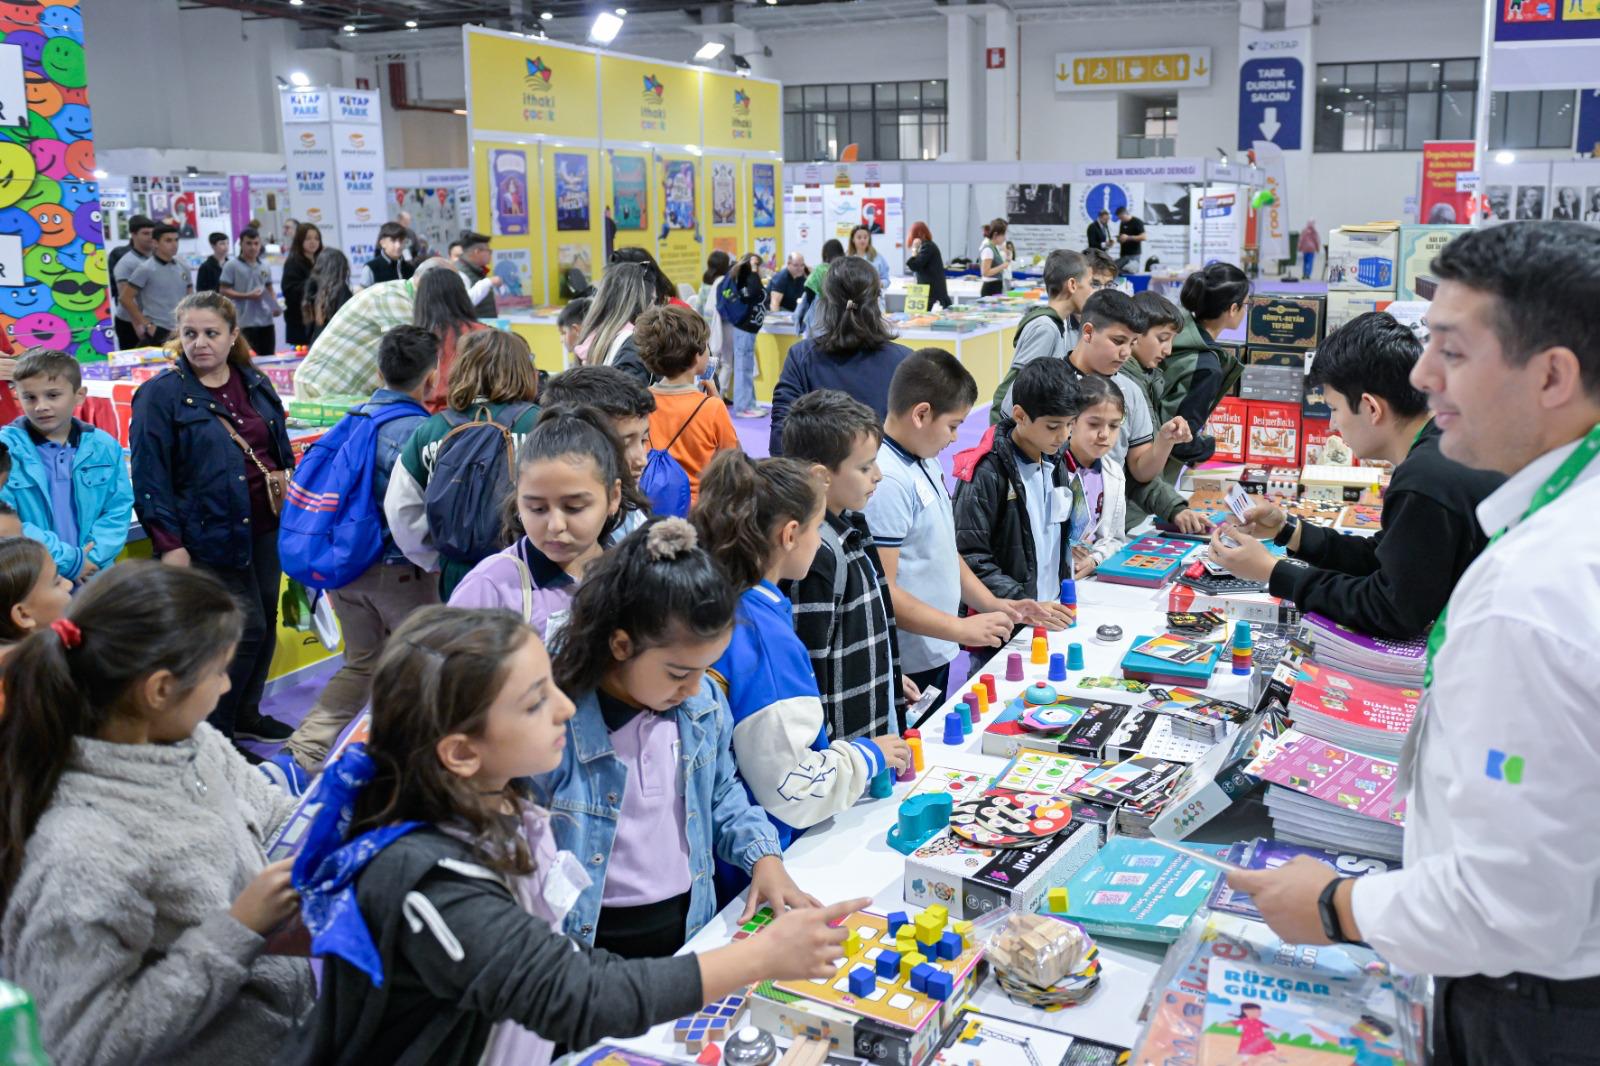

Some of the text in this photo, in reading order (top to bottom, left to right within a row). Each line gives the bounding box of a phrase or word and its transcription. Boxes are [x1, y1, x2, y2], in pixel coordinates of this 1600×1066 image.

[1258, 68, 1285, 79] TARIK
[1246, 80, 1285, 91] DURSUN
[523, 91, 555, 108] ithaki
[1251, 91, 1290, 103] SALONU
[293, 106, 318, 115] PARK
[342, 107, 368, 117] PARK
[523, 108, 555, 122] çock
[641, 119, 666, 132] çock
[296, 171, 325, 181] KİTAP
[344, 170, 374, 181] KİTAP
[299, 182, 324, 192] PARK
[347, 181, 374, 191] PARK
[351, 244, 375, 255] KİTA
[908, 300, 925, 310] 35
[1224, 969, 1331, 996] RÜZGAR
[1224, 983, 1289, 1004] GÜLÜ
